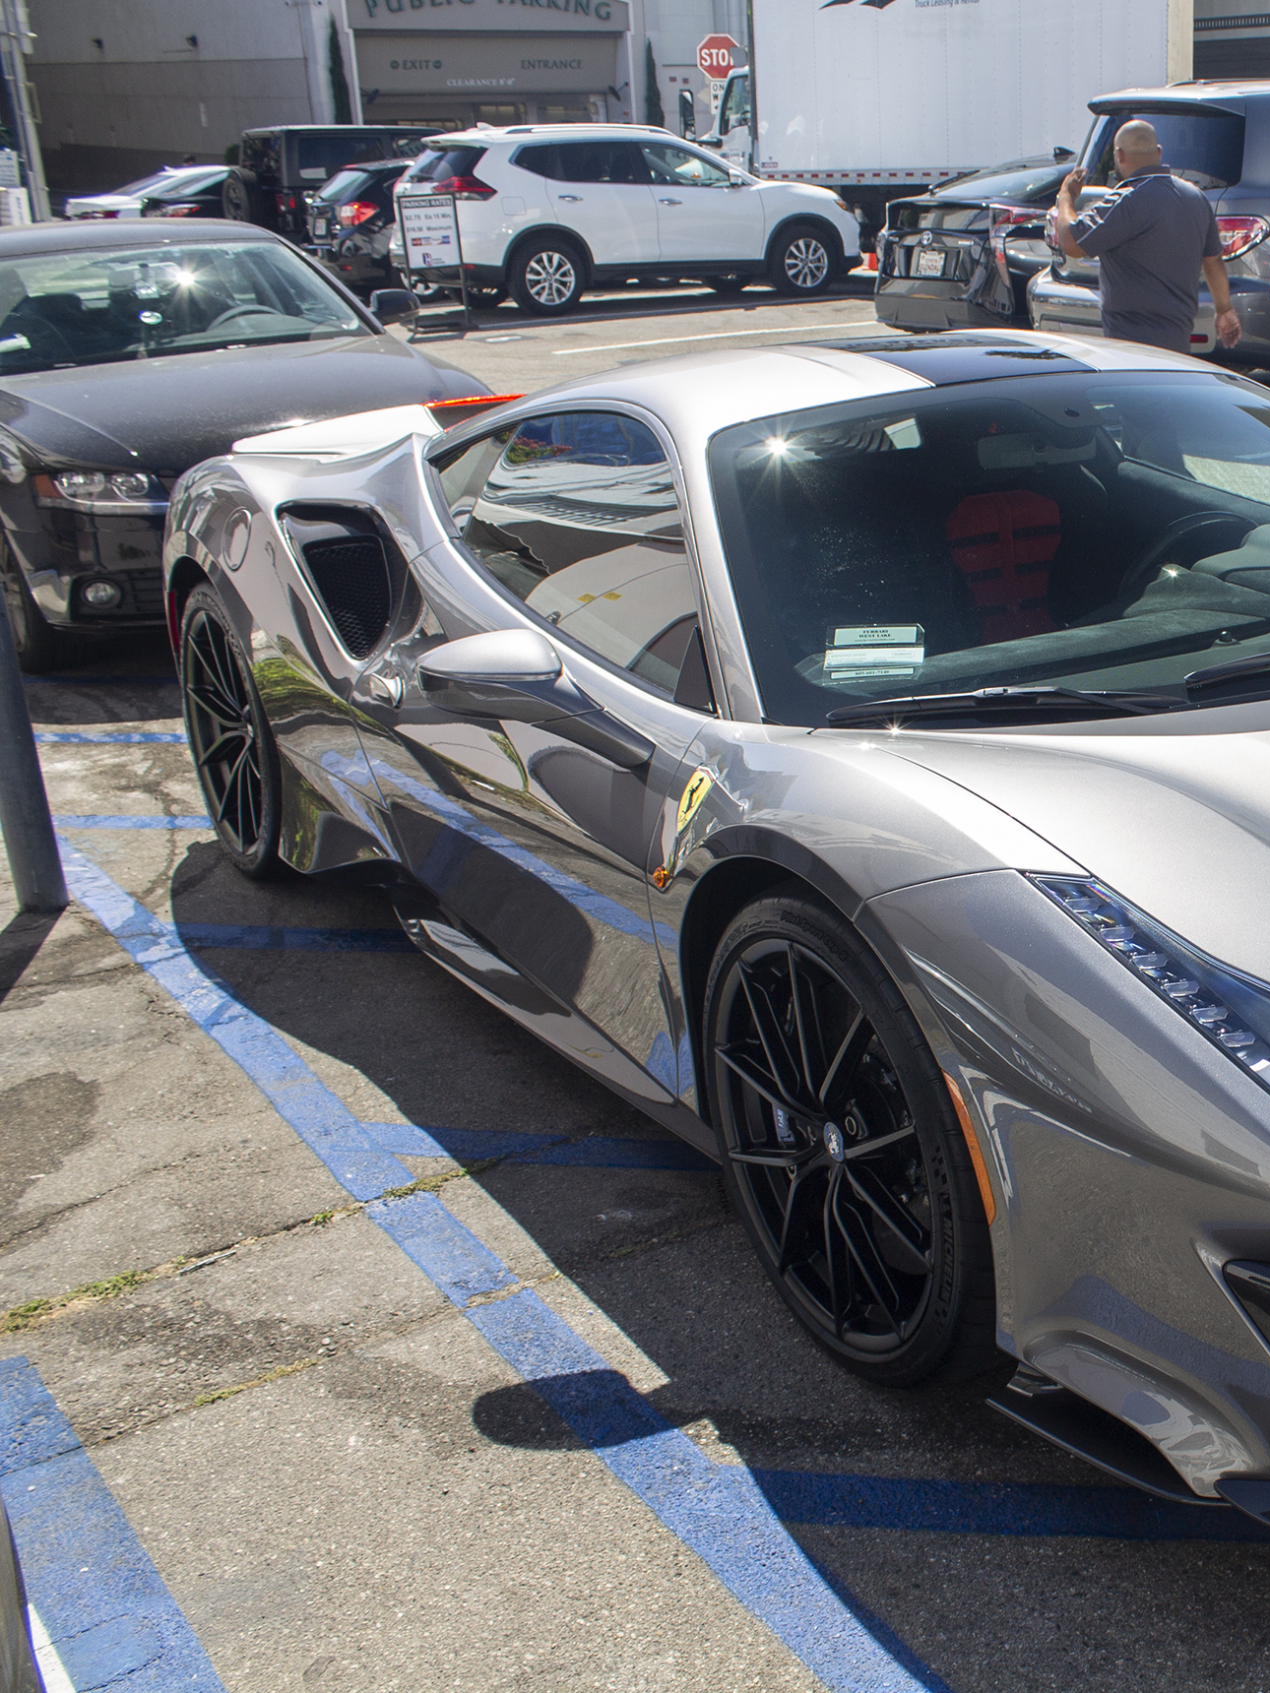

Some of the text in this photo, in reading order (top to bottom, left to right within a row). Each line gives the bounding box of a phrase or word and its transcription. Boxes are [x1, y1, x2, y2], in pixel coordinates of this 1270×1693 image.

[701, 48, 734, 67] STO
[402, 59, 432, 71] EXIT
[520, 59, 583, 70] ENTRANCE
[446, 78, 498, 87] CLEARANCE
[712, 83, 725, 92] ON
[402, 198, 452, 208] PARKING RATES
[780, 909, 801, 926] Pilot
[799, 917, 825, 941] Sport
[823, 935, 840, 955] Cup
[940, 1216, 954, 1303] MICHELIN
